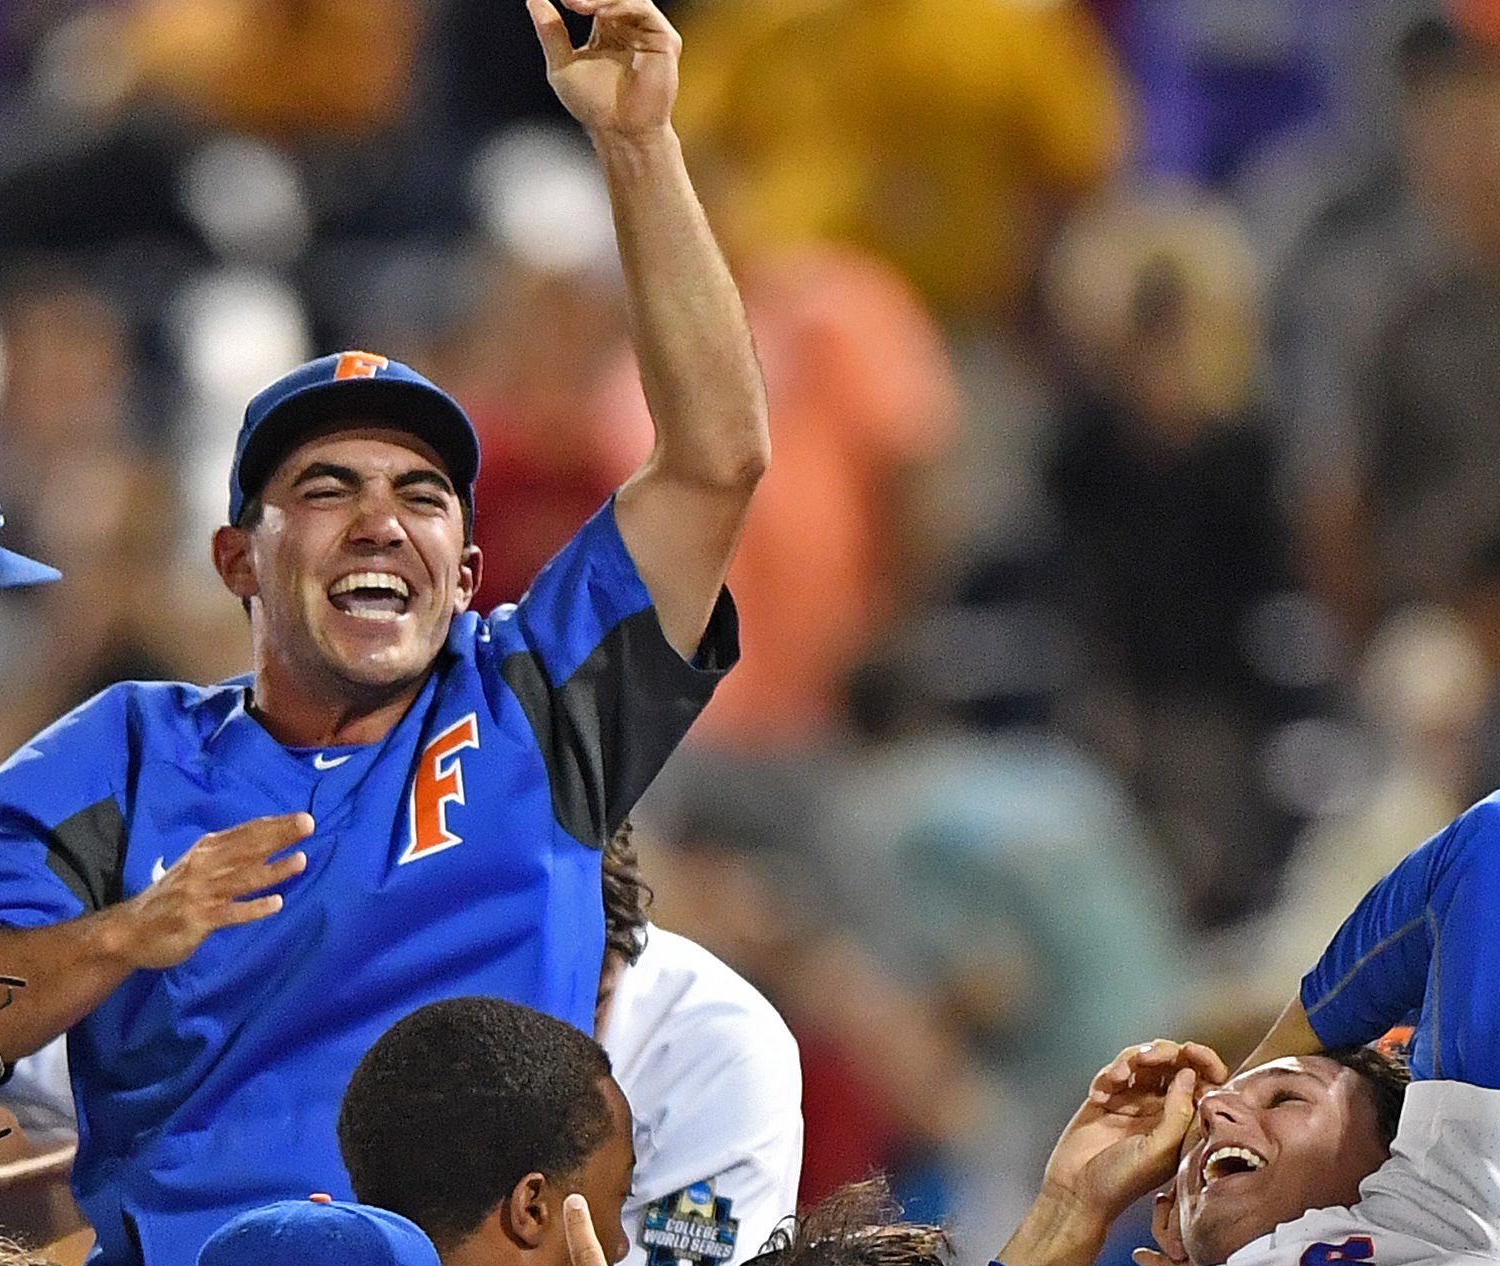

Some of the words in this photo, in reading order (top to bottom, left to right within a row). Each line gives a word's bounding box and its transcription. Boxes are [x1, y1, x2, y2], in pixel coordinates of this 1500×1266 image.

[397, 712, 480, 866] F
[643, 1229, 690, 1251] WORLD
[690, 1239, 734, 1259] SERIES
[665, 1219, 719, 1241] COLLEGE
